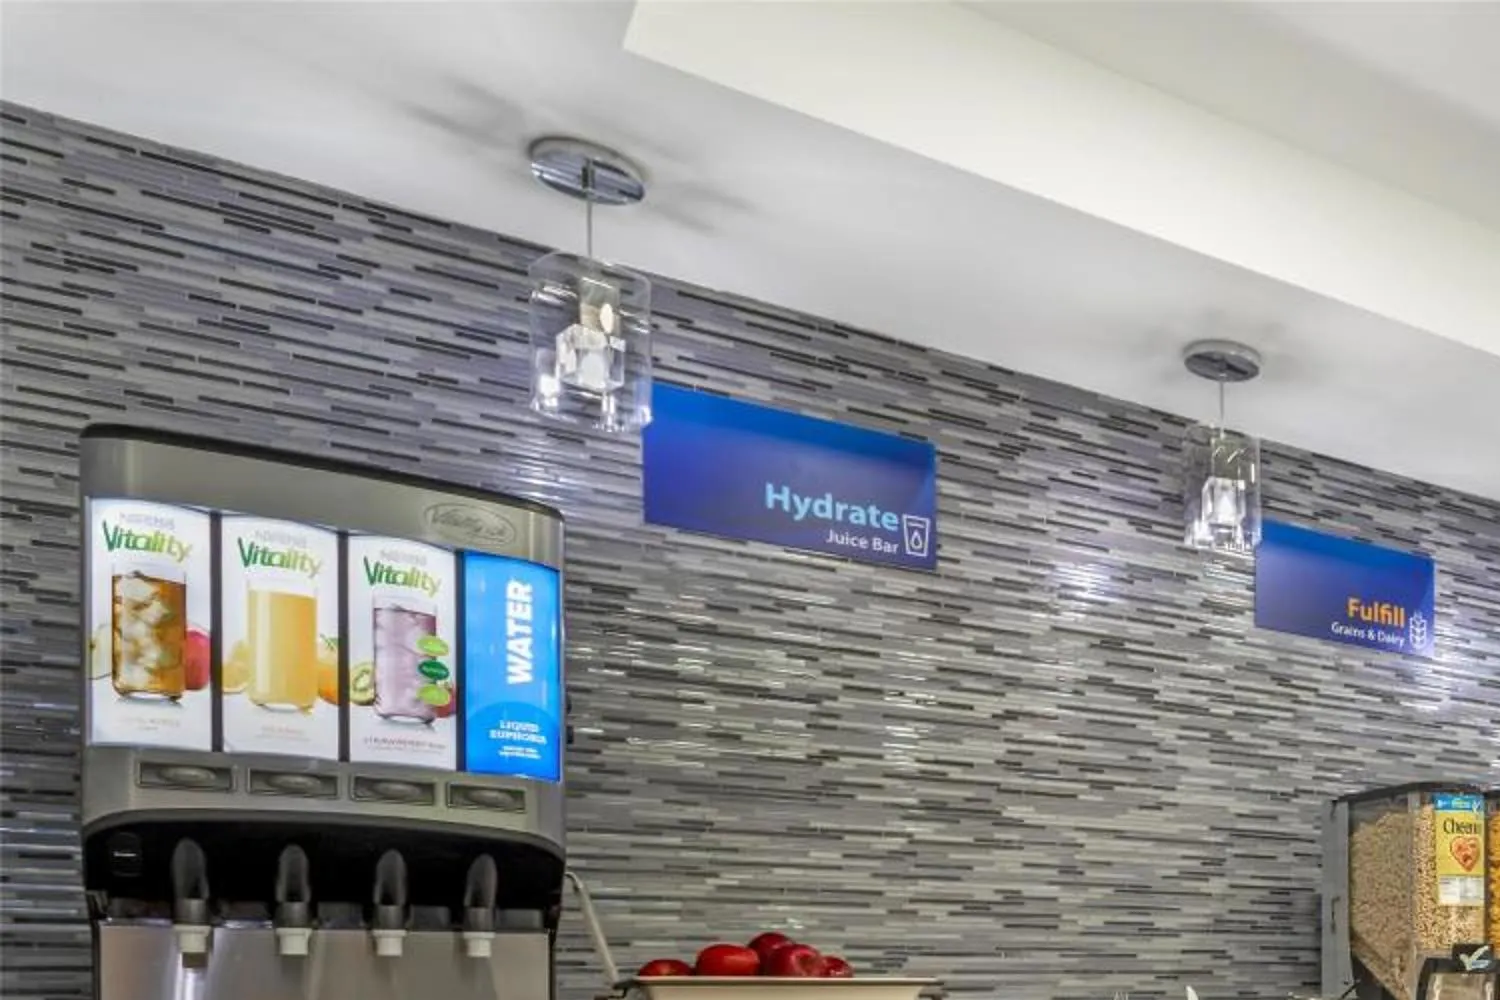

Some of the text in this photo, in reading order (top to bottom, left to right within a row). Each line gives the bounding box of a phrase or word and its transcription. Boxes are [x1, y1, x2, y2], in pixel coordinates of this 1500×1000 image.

[765, 482, 898, 530] Hydrate
[102, 519, 193, 564] Vitality
[237, 535, 323, 578] Vitality
[826, 528, 899, 555] Juice Bar
[363, 555, 443, 598] Vitality
[506, 578, 533, 686] WATER
[1331, 621, 1406, 648] Grains & Dairy
[1347, 598, 1405, 628] Fulfill
